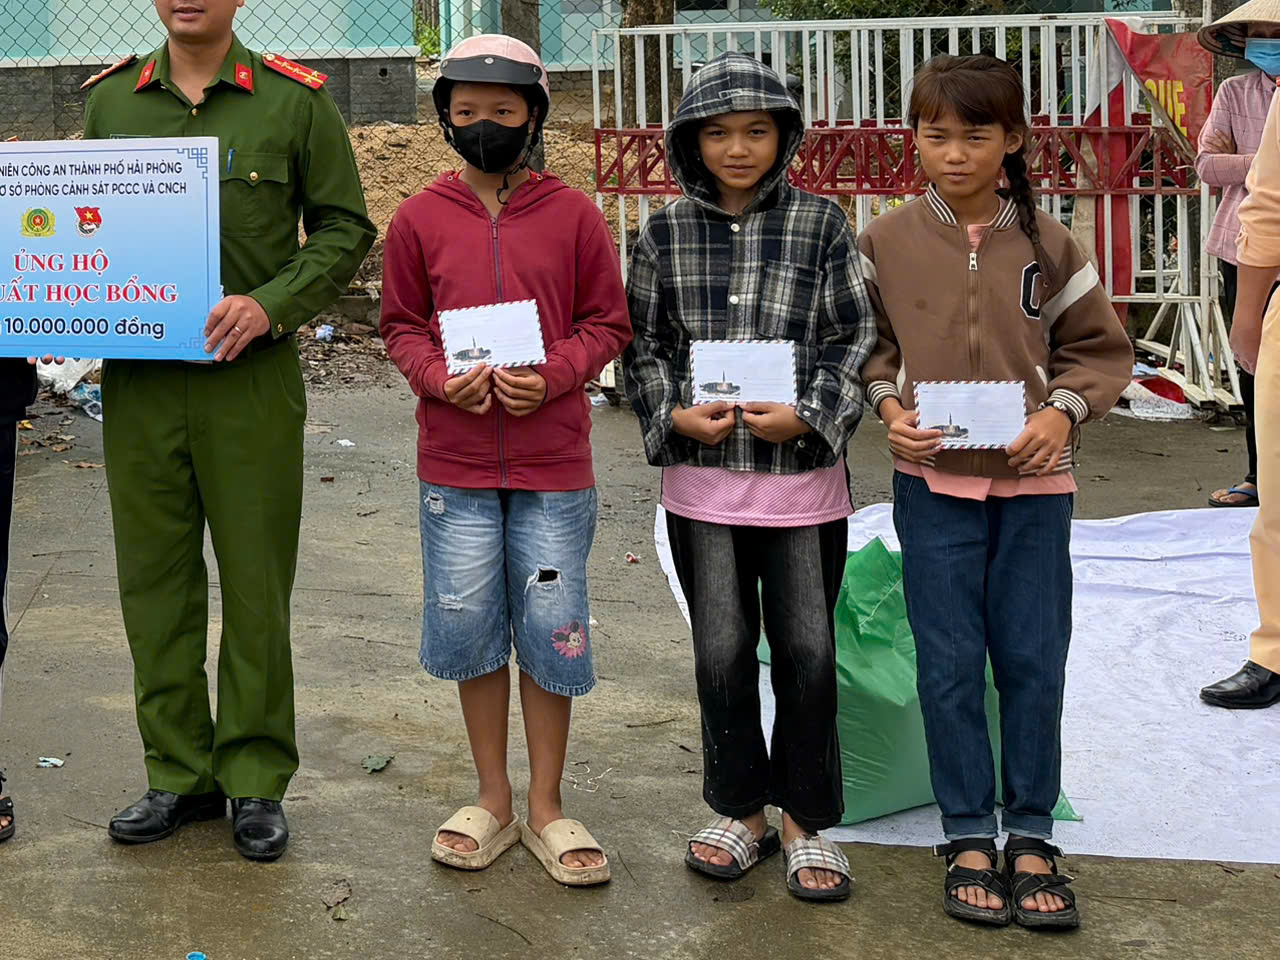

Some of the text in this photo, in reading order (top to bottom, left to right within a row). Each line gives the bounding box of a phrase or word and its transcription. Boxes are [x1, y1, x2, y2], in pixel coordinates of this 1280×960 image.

[21, 162, 51, 177] CÔNG
[53, 164, 67, 176] AN
[103, 159, 125, 175] PHỐ
[112, 182, 140, 195] PCCC
[158, 181, 187, 194] CNCH
[13, 248, 109, 275] ỦNG HỘ
[45, 284, 99, 306] HỌC
[106, 275, 177, 302] BỔNG
[4, 317, 109, 334] 10.000.000
[114, 316, 164, 340] đồng
